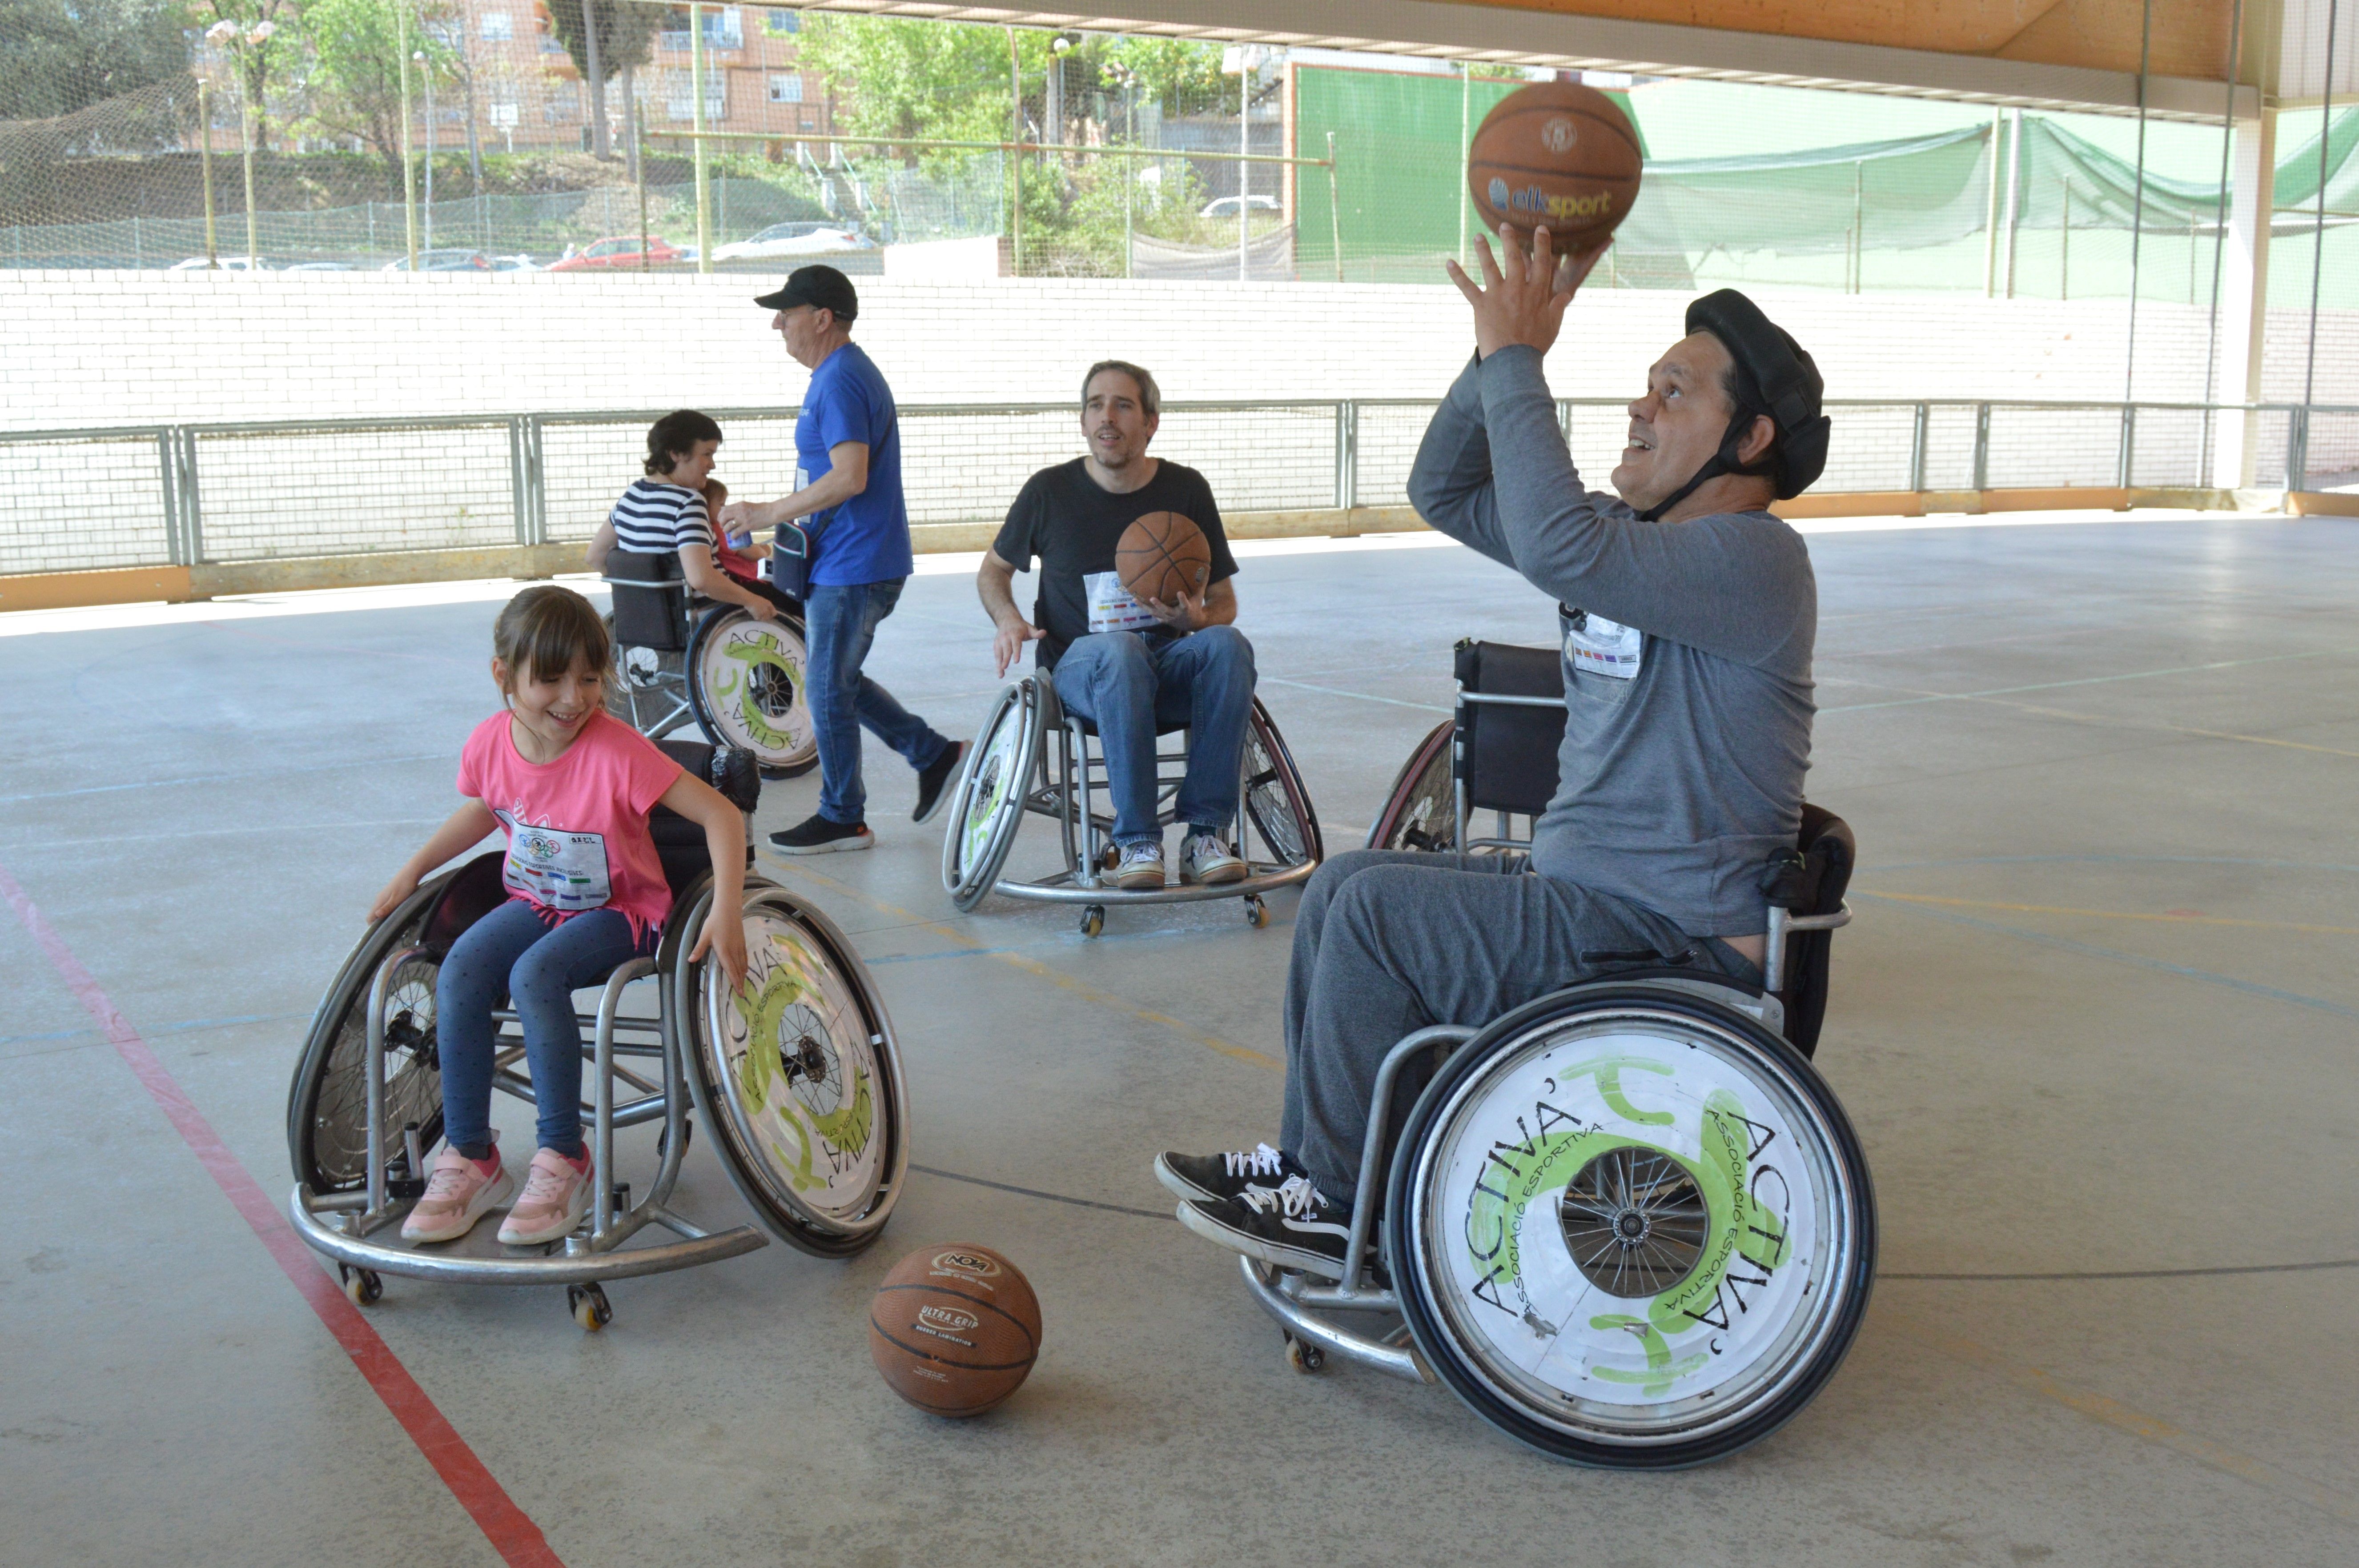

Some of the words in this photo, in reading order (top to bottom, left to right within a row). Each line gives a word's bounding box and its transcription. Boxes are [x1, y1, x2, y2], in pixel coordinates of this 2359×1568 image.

[729, 629, 804, 673] ACTIVA'
[724, 702, 801, 750] ACTIVA'
[758, 981, 796, 1012] ESPORTIVA
[1522, 1123, 1604, 1197] ESPORTIVA
[1707, 1110, 1745, 1222] ASSOCIACIÓ
[1465, 1078, 1582, 1317] ACTIVA'
[944, 1254, 990, 1272] NOVA
[1511, 1203, 1537, 1316] ASSOCIACIÓ
[1683, 1111, 1790, 1355] ACTIVA'
[1664, 1227, 1738, 1311] ESPORTIVA
[921, 1305, 952, 1322] ULTRA
[954, 1316, 979, 1329] GRIP
[938, 1332, 972, 1346] LAMINATION
